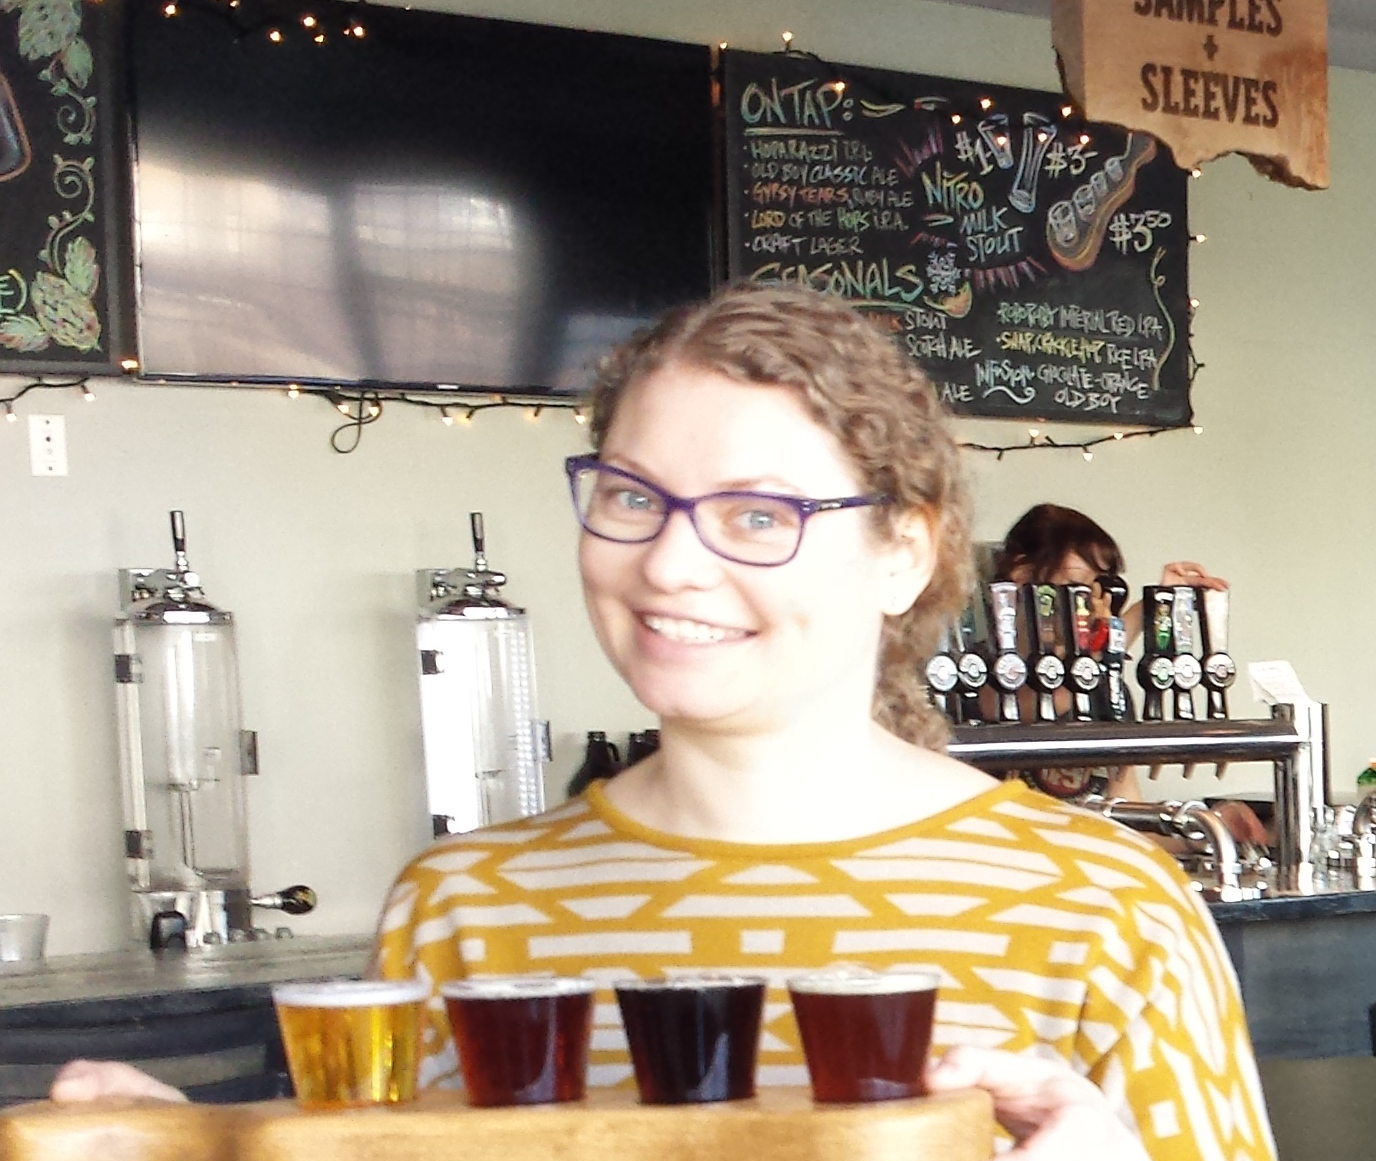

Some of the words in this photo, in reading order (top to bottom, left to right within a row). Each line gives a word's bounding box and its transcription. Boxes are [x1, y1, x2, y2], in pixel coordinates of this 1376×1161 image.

[1140, 62, 1280, 128] SLEEVES
[809, 164, 868, 185] CLASSIC
[920, 161, 985, 212] NITRO
[752, 181, 797, 207] GYPSY
[752, 209, 786, 229] LORD
[960, 205, 1010, 235] MILK
[752, 233, 807, 256] CRAFT
[810, 236, 865, 256] LAGER
[966, 227, 1024, 262] STOUT
[904, 307, 948, 330] STOUT
[941, 380, 974, 404] ALE
[1054, 387, 1086, 409] OLD
[1084, 392, 1122, 414] BOY
